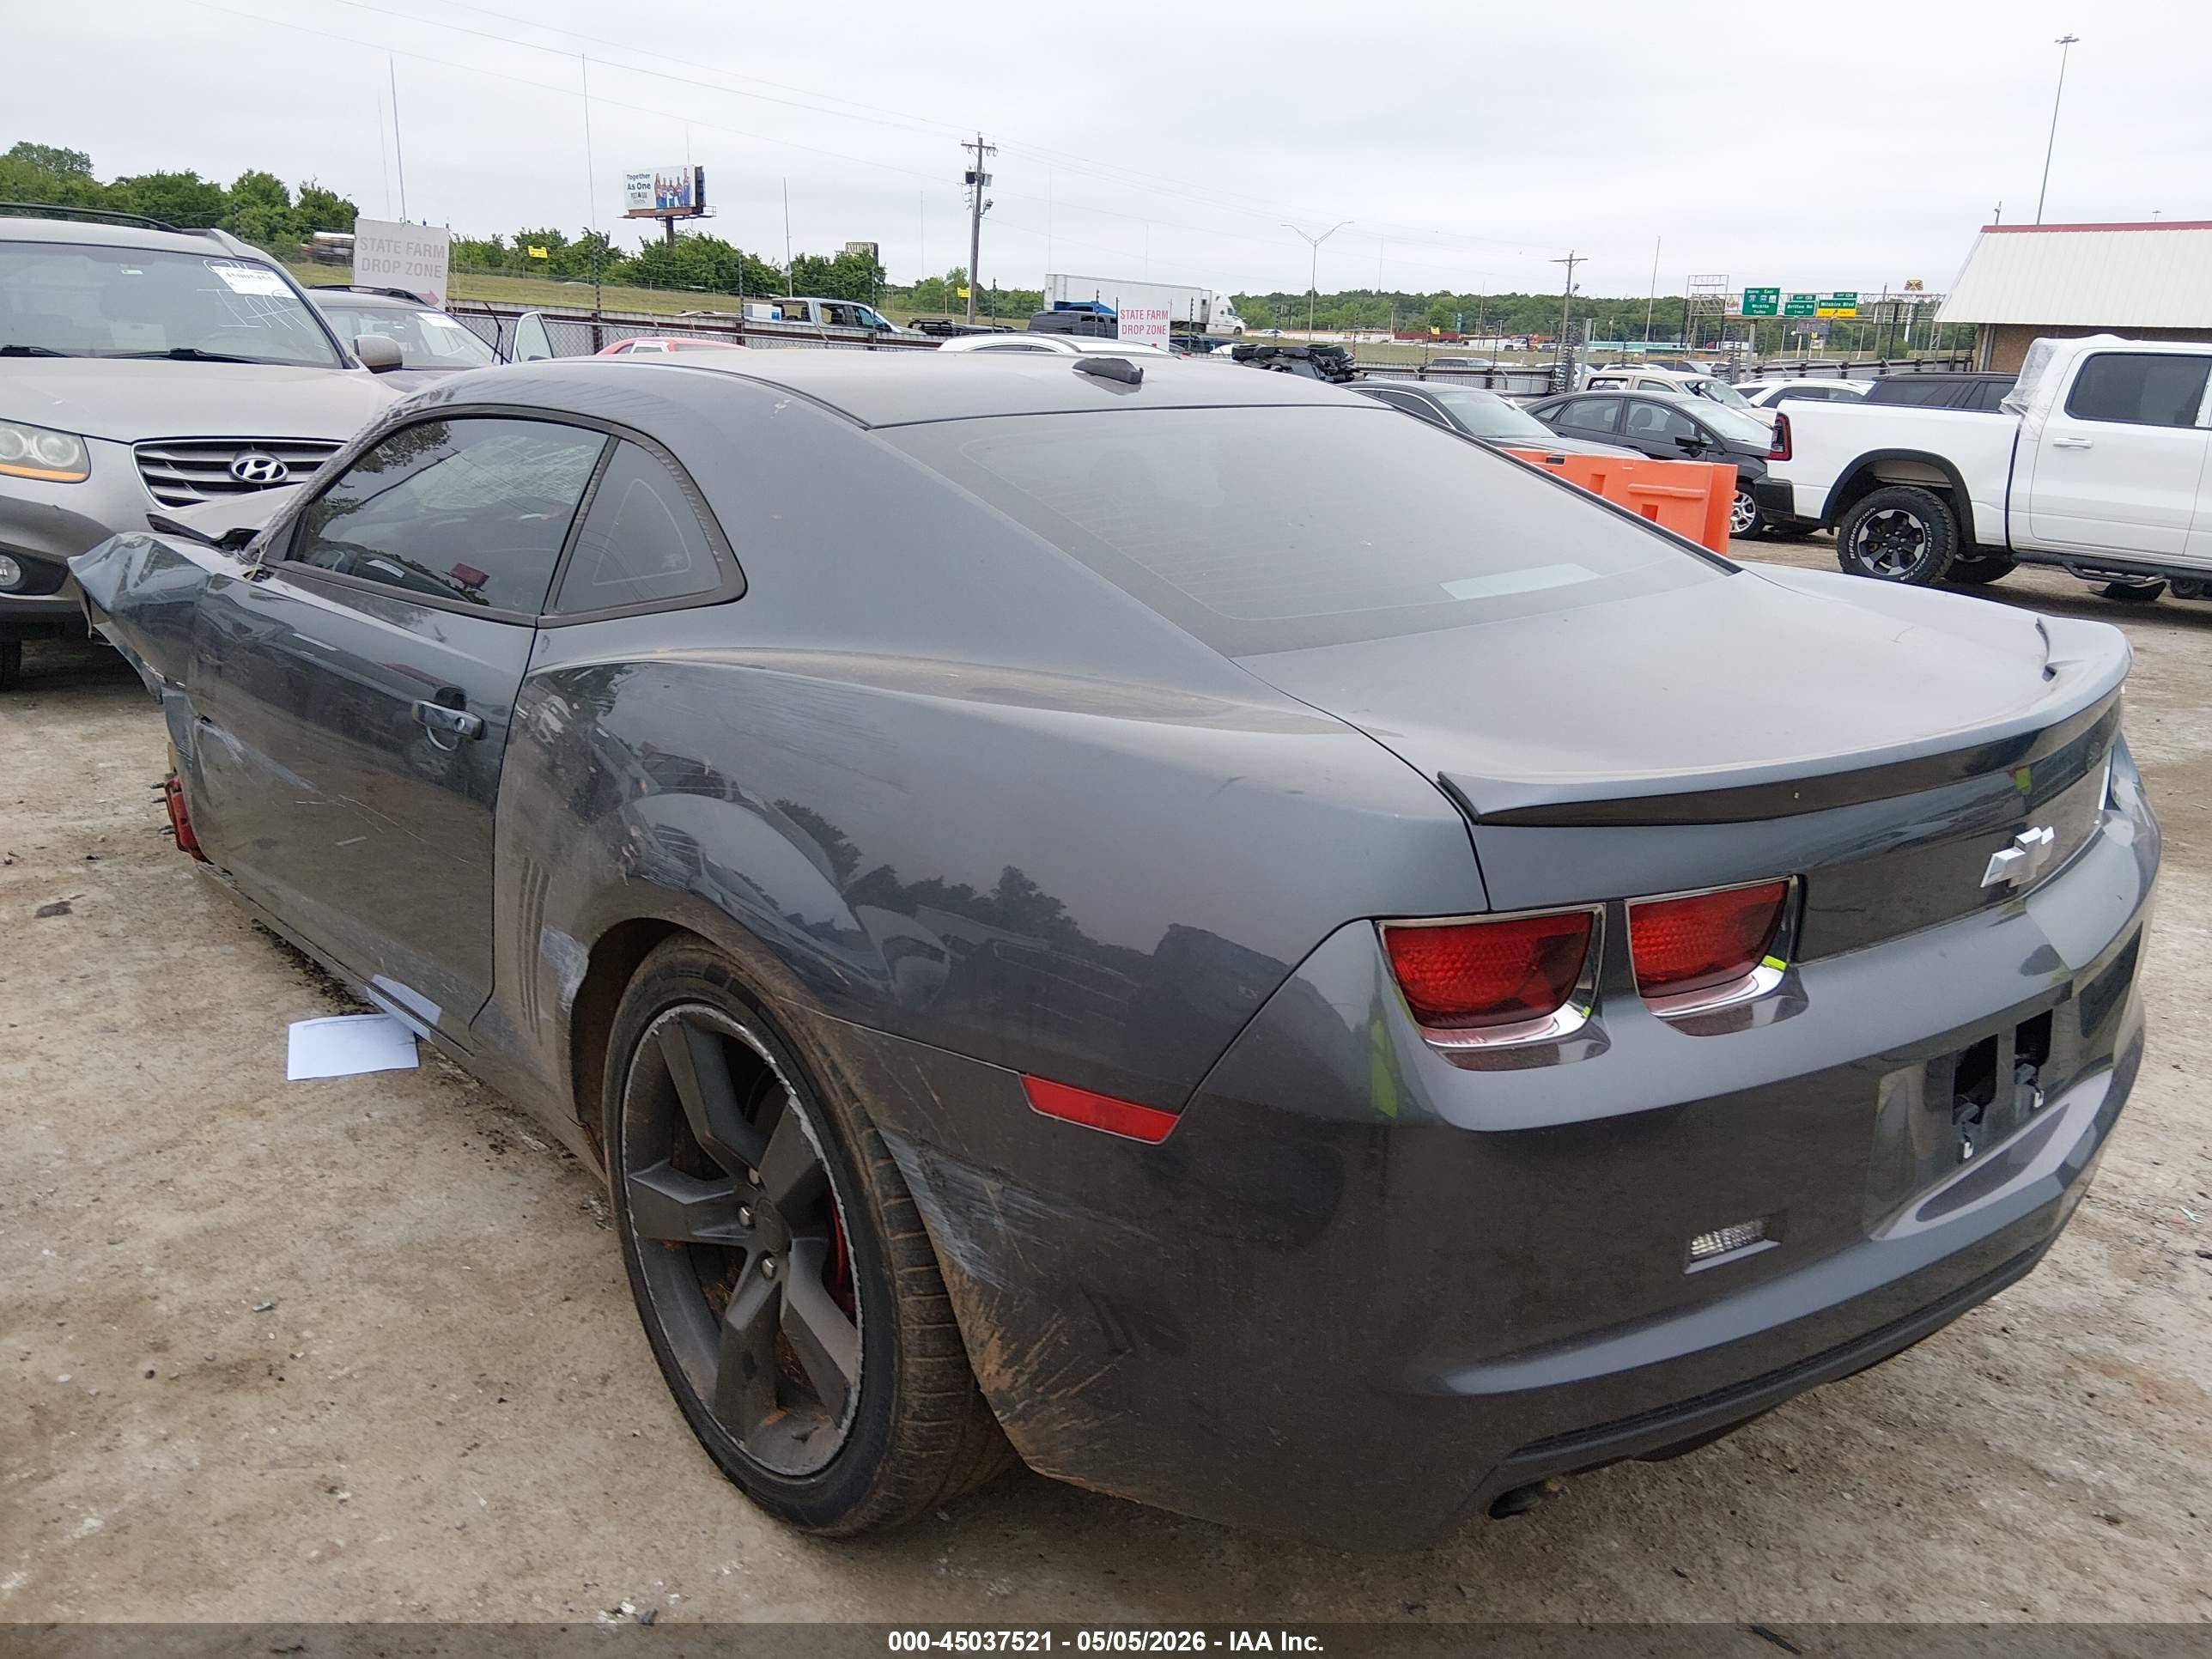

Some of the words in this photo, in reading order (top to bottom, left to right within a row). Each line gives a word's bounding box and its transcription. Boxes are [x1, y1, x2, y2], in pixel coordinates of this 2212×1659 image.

[359, 237, 401, 254] STATE
[406, 241, 445, 259] FARM
[362, 258, 401, 274] DROP
[405, 261, 442, 278] ZONE
[1120, 309, 1144, 319] STATE
[1146, 309, 1169, 320] FARM
[1121, 325, 1144, 335] DROP
[1146, 325, 1167, 335] ZONE
